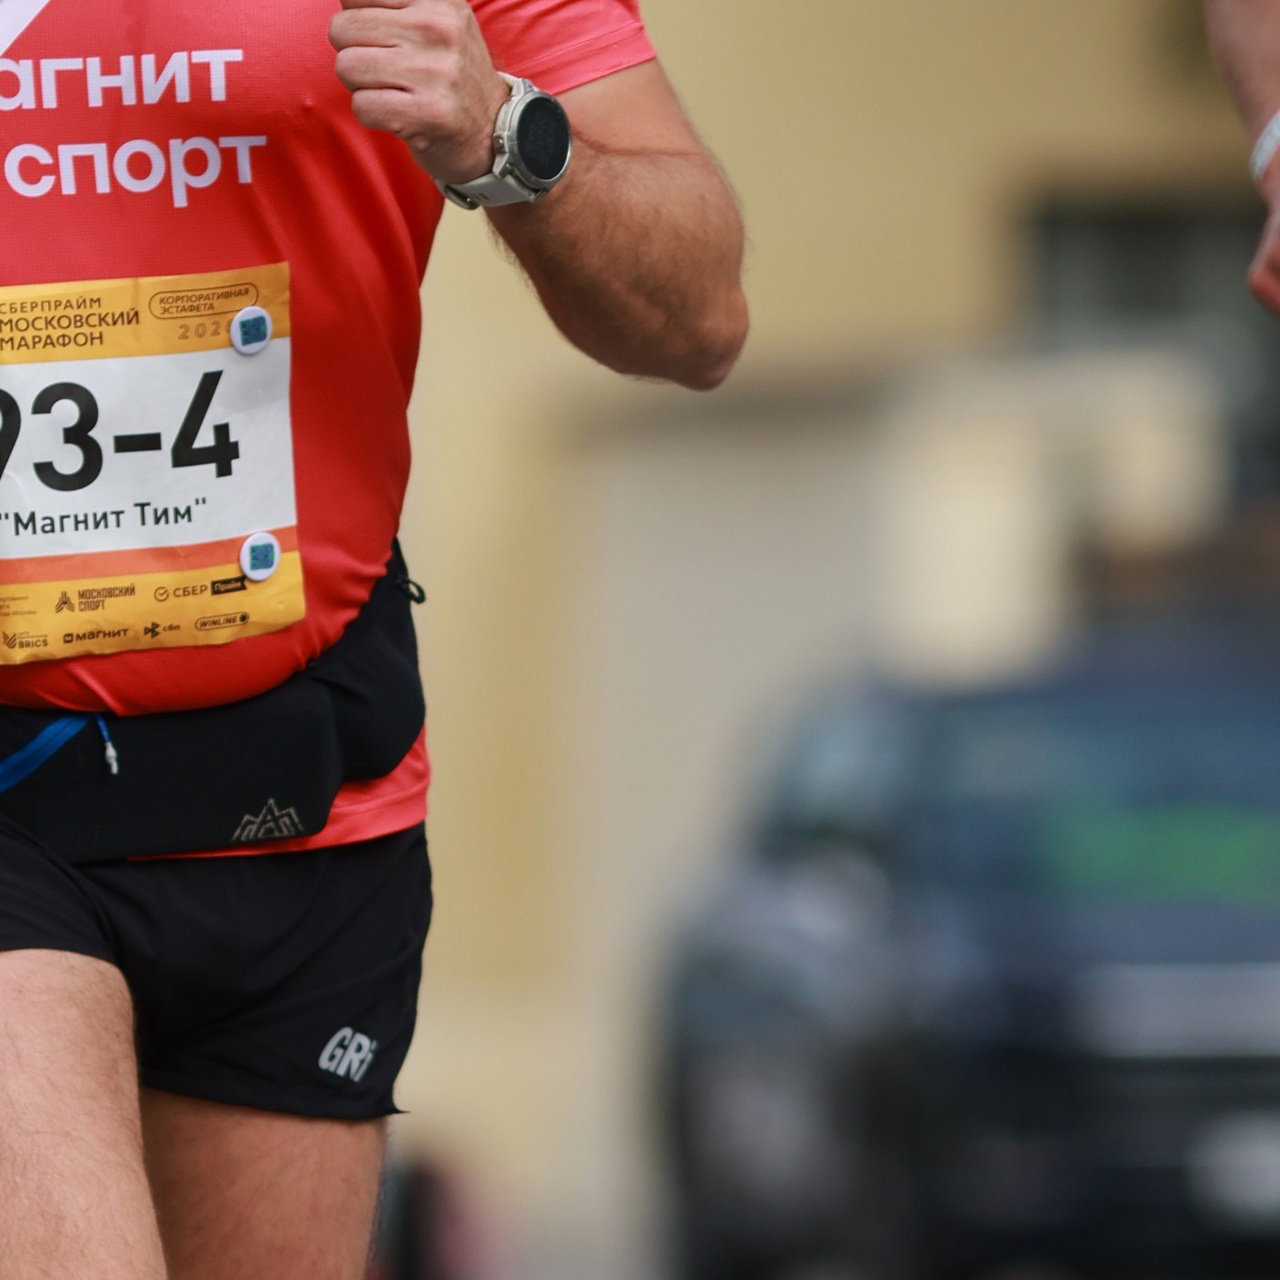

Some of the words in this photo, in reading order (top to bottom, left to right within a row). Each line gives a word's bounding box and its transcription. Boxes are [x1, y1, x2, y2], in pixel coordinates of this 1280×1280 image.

[6, 136, 267, 208] спорт
[159, 288, 249, 305] КОРПОРАТИВНАЯ
[160, 303, 214, 315] ЭСТАФЕТА
[0, 331, 104, 352] МАРАФОН
[134, 498, 208, 526] Тим"
[78, 583, 135, 599] МОСКОВСКИЙ
[173, 584, 207, 597] СБЕР
[78, 600, 106, 612] СПОРТ
[163, 623, 181, 632] сбп
[199, 616, 238, 628] WINLINE
[76, 629, 129, 641] магнит
[18, 640, 48, 649] BRICS
